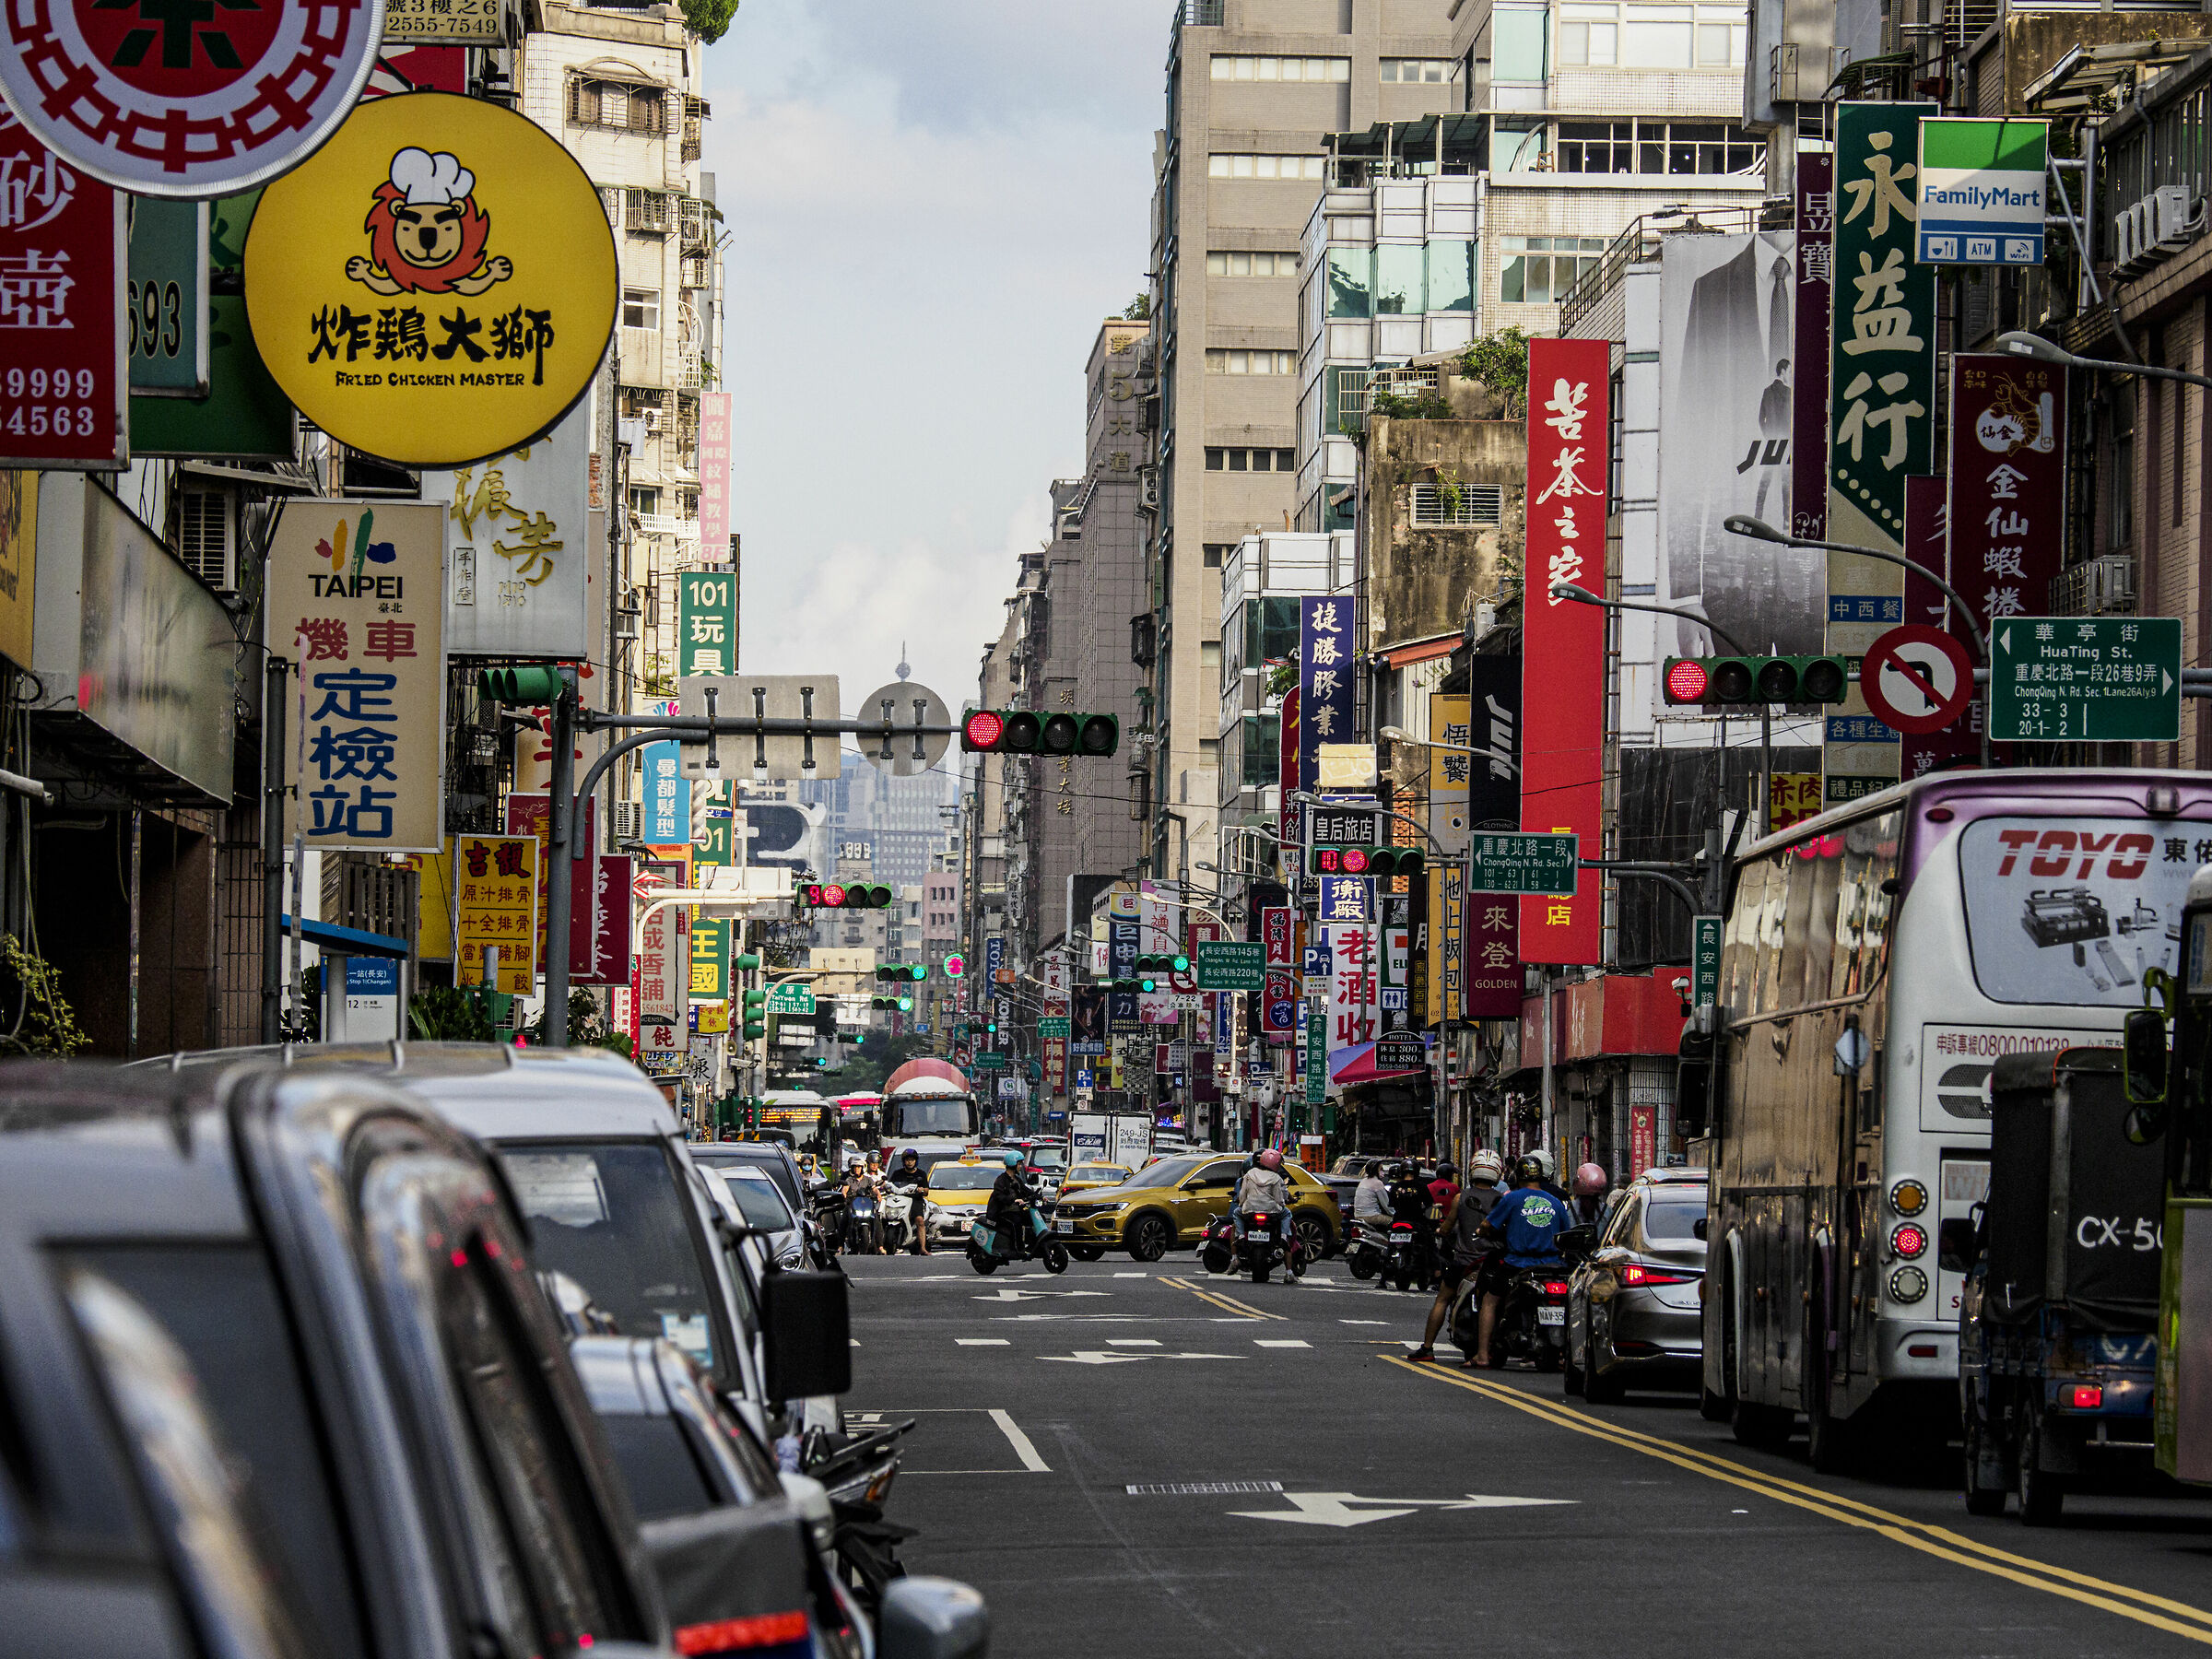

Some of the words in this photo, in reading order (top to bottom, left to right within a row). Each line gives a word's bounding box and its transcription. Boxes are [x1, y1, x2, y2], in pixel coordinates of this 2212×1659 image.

[389, 17, 497, 33] 2555-7549
[1924, 185, 2040, 210] FamilyMart
[1971, 242, 1992, 256] ATM
[1837, 131, 1924, 471] 永益行
[0, 369, 94, 398] 9999
[0, 406, 94, 436] 4563
[1736, 439, 1791, 475] JU
[701, 546, 726, 561] 8F
[308, 573, 403, 599] TAIPEI
[378, 603, 403, 614] 臺北
[1834, 599, 1900, 619] 中西餐
[293, 617, 417, 662] 機車
[2035, 623, 2139, 642] 華亭街
[2041, 645, 2100, 661] HuaTing
[2111, 646, 2134, 658] St.
[1311, 601, 1344, 761] 捷勝膠業
[2015, 663, 2158, 683] 重慶北路一段26巷9弄
[2014, 685, 2056, 700] ChongQing
[2060, 703, 2067, 718] 3
[2059, 720, 2067, 735] 2
[307, 667, 398, 839] 定檢站
[655, 759, 677, 837] 曼都髮型
[1314, 816, 1373, 842] 皇后旅店
[1482, 837, 1567, 857] 重慶北路一段
[1996, 830, 2155, 880] TOYO
[1483, 857, 1522, 869] ChongQing
[1507, 869, 1516, 878] 63
[463, 886, 531, 903] 原汁排骨
[1330, 877, 1364, 919] 衡廠
[462, 914, 530, 933] 十全排骨
[1481, 905, 1514, 970] 來登
[1305, 949, 1318, 969] P
[1701, 931, 1716, 1006] 長安西路
[347, 970, 387, 978] 一站(長安)
[1475, 979, 1518, 990] GOLDEN
[1312, 1023, 1322, 1074] 長安西路
[1399, 1045, 1418, 1053] 300
[1399, 1054, 1418, 1063] 880
[1120, 1129, 1148, 1138] 249-JS
